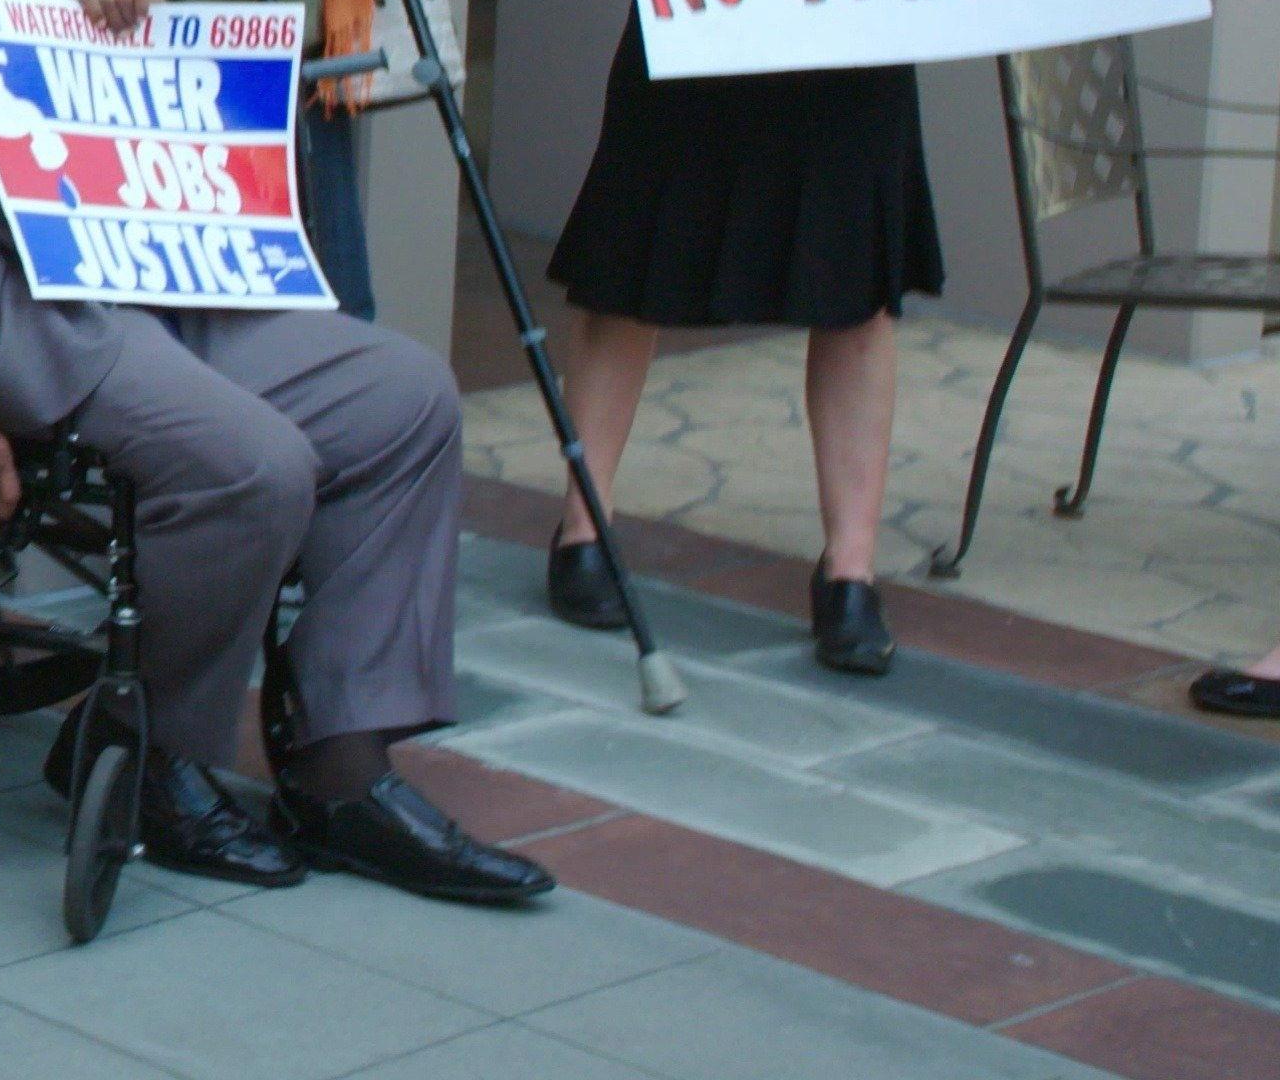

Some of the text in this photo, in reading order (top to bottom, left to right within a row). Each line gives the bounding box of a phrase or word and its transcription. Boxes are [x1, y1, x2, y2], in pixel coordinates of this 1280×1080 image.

[167, 14, 201, 47] TO
[209, 14, 297, 50] 69866
[34, 46, 225, 131] WATER
[113, 137, 242, 216] JOBS
[69, 217, 278, 296] JUSTICE
